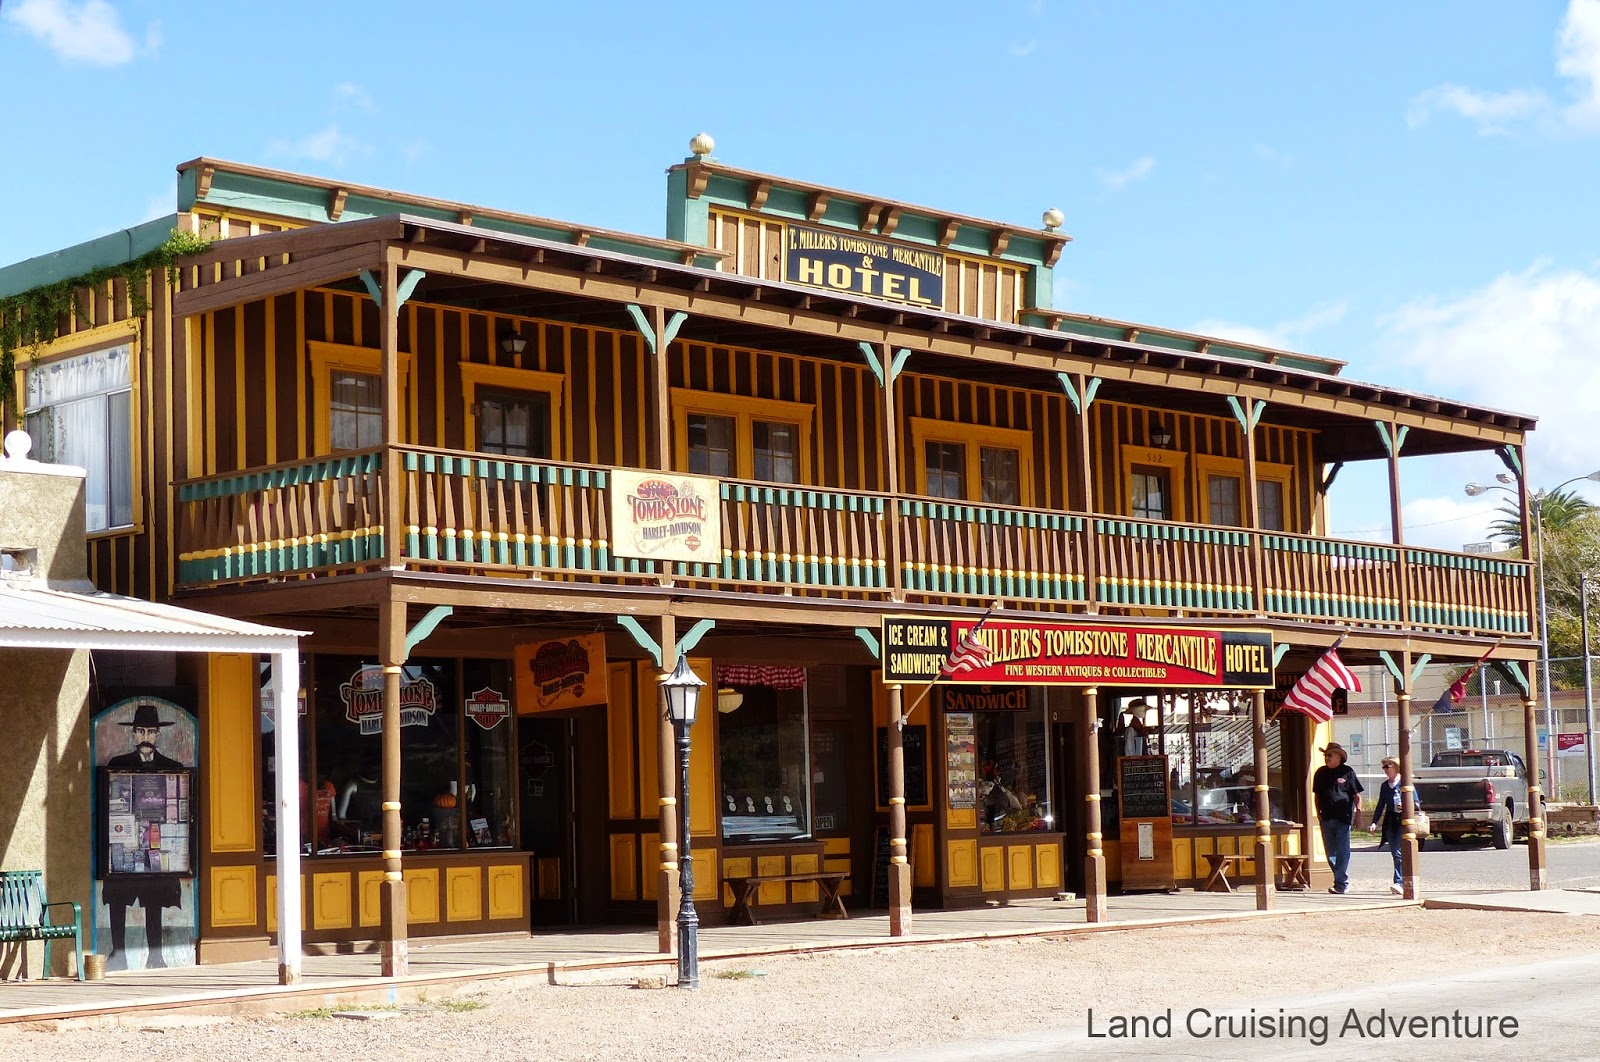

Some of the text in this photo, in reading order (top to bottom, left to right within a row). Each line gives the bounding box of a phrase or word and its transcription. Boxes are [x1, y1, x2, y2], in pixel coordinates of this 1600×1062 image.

[799, 230, 838, 250] MILLER'S
[838, 237, 889, 259] TOMBSTONE
[892, 247, 942, 278] MERCANTILE
[862, 255, 873, 269] &
[799, 257, 932, 304] HOTEL
[627, 494, 707, 525] TOMBSTONE
[642, 521, 702, 541] HARLEY-DAVIDSON
[888, 624, 948, 647] ICE CREAM &
[1044, 629, 1129, 657] TOMBSTONE
[1135, 633, 1217, 676] MERCANTILE
[1225, 644, 1269, 673] HOTEL
[890, 653, 948, 675] SANDWICHES
[1005, 664, 1167, 679] FINE WESTERN ANTIQUES & COLLECTIBLES
[469, 703, 506, 713] HARLEY-DAVIDSON
[946, 687, 1028, 710] SANDWICH
[816, 816, 834, 829] OPEN
